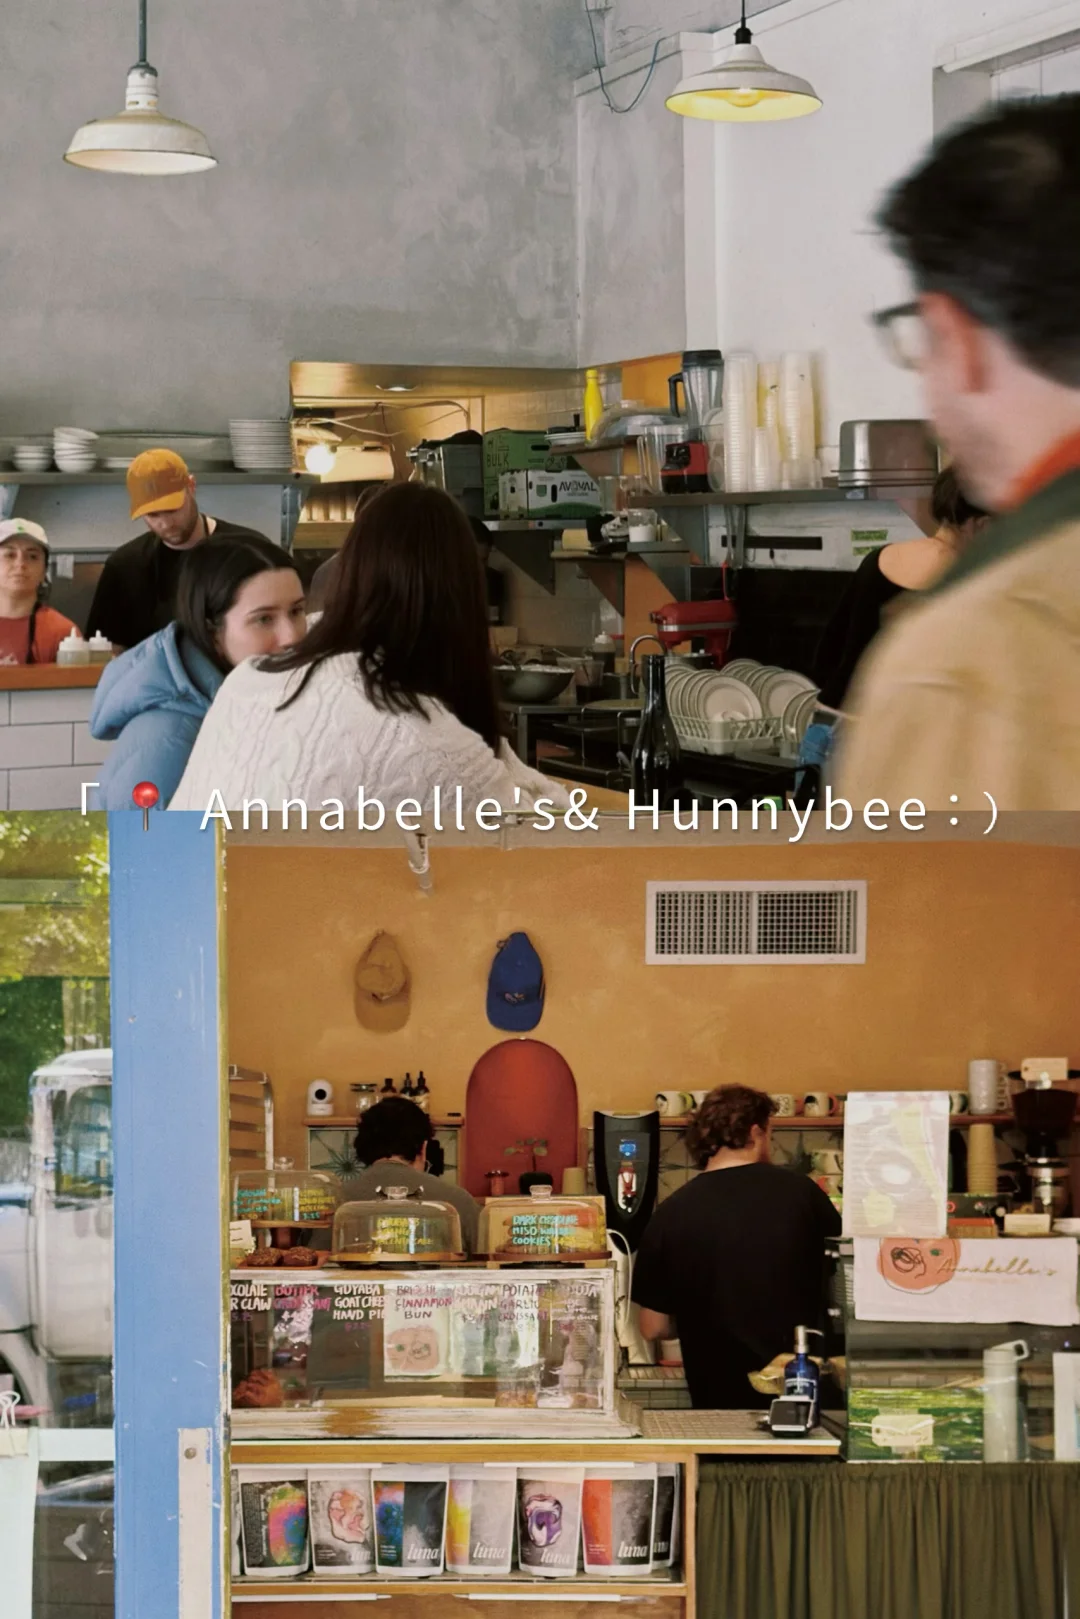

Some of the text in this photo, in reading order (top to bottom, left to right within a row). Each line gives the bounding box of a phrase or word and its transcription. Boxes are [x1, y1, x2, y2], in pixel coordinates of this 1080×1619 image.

[512, 1236, 551, 1247] COOKIES
[240, 1297, 272, 1311] CLAW
[332, 1309, 364, 1320] HAND
[404, 1311, 432, 1320] BUN
[407, 1543, 440, 1560] luna
[473, 1542, 505, 1559] luna
[618, 1541, 649, 1558] luna
